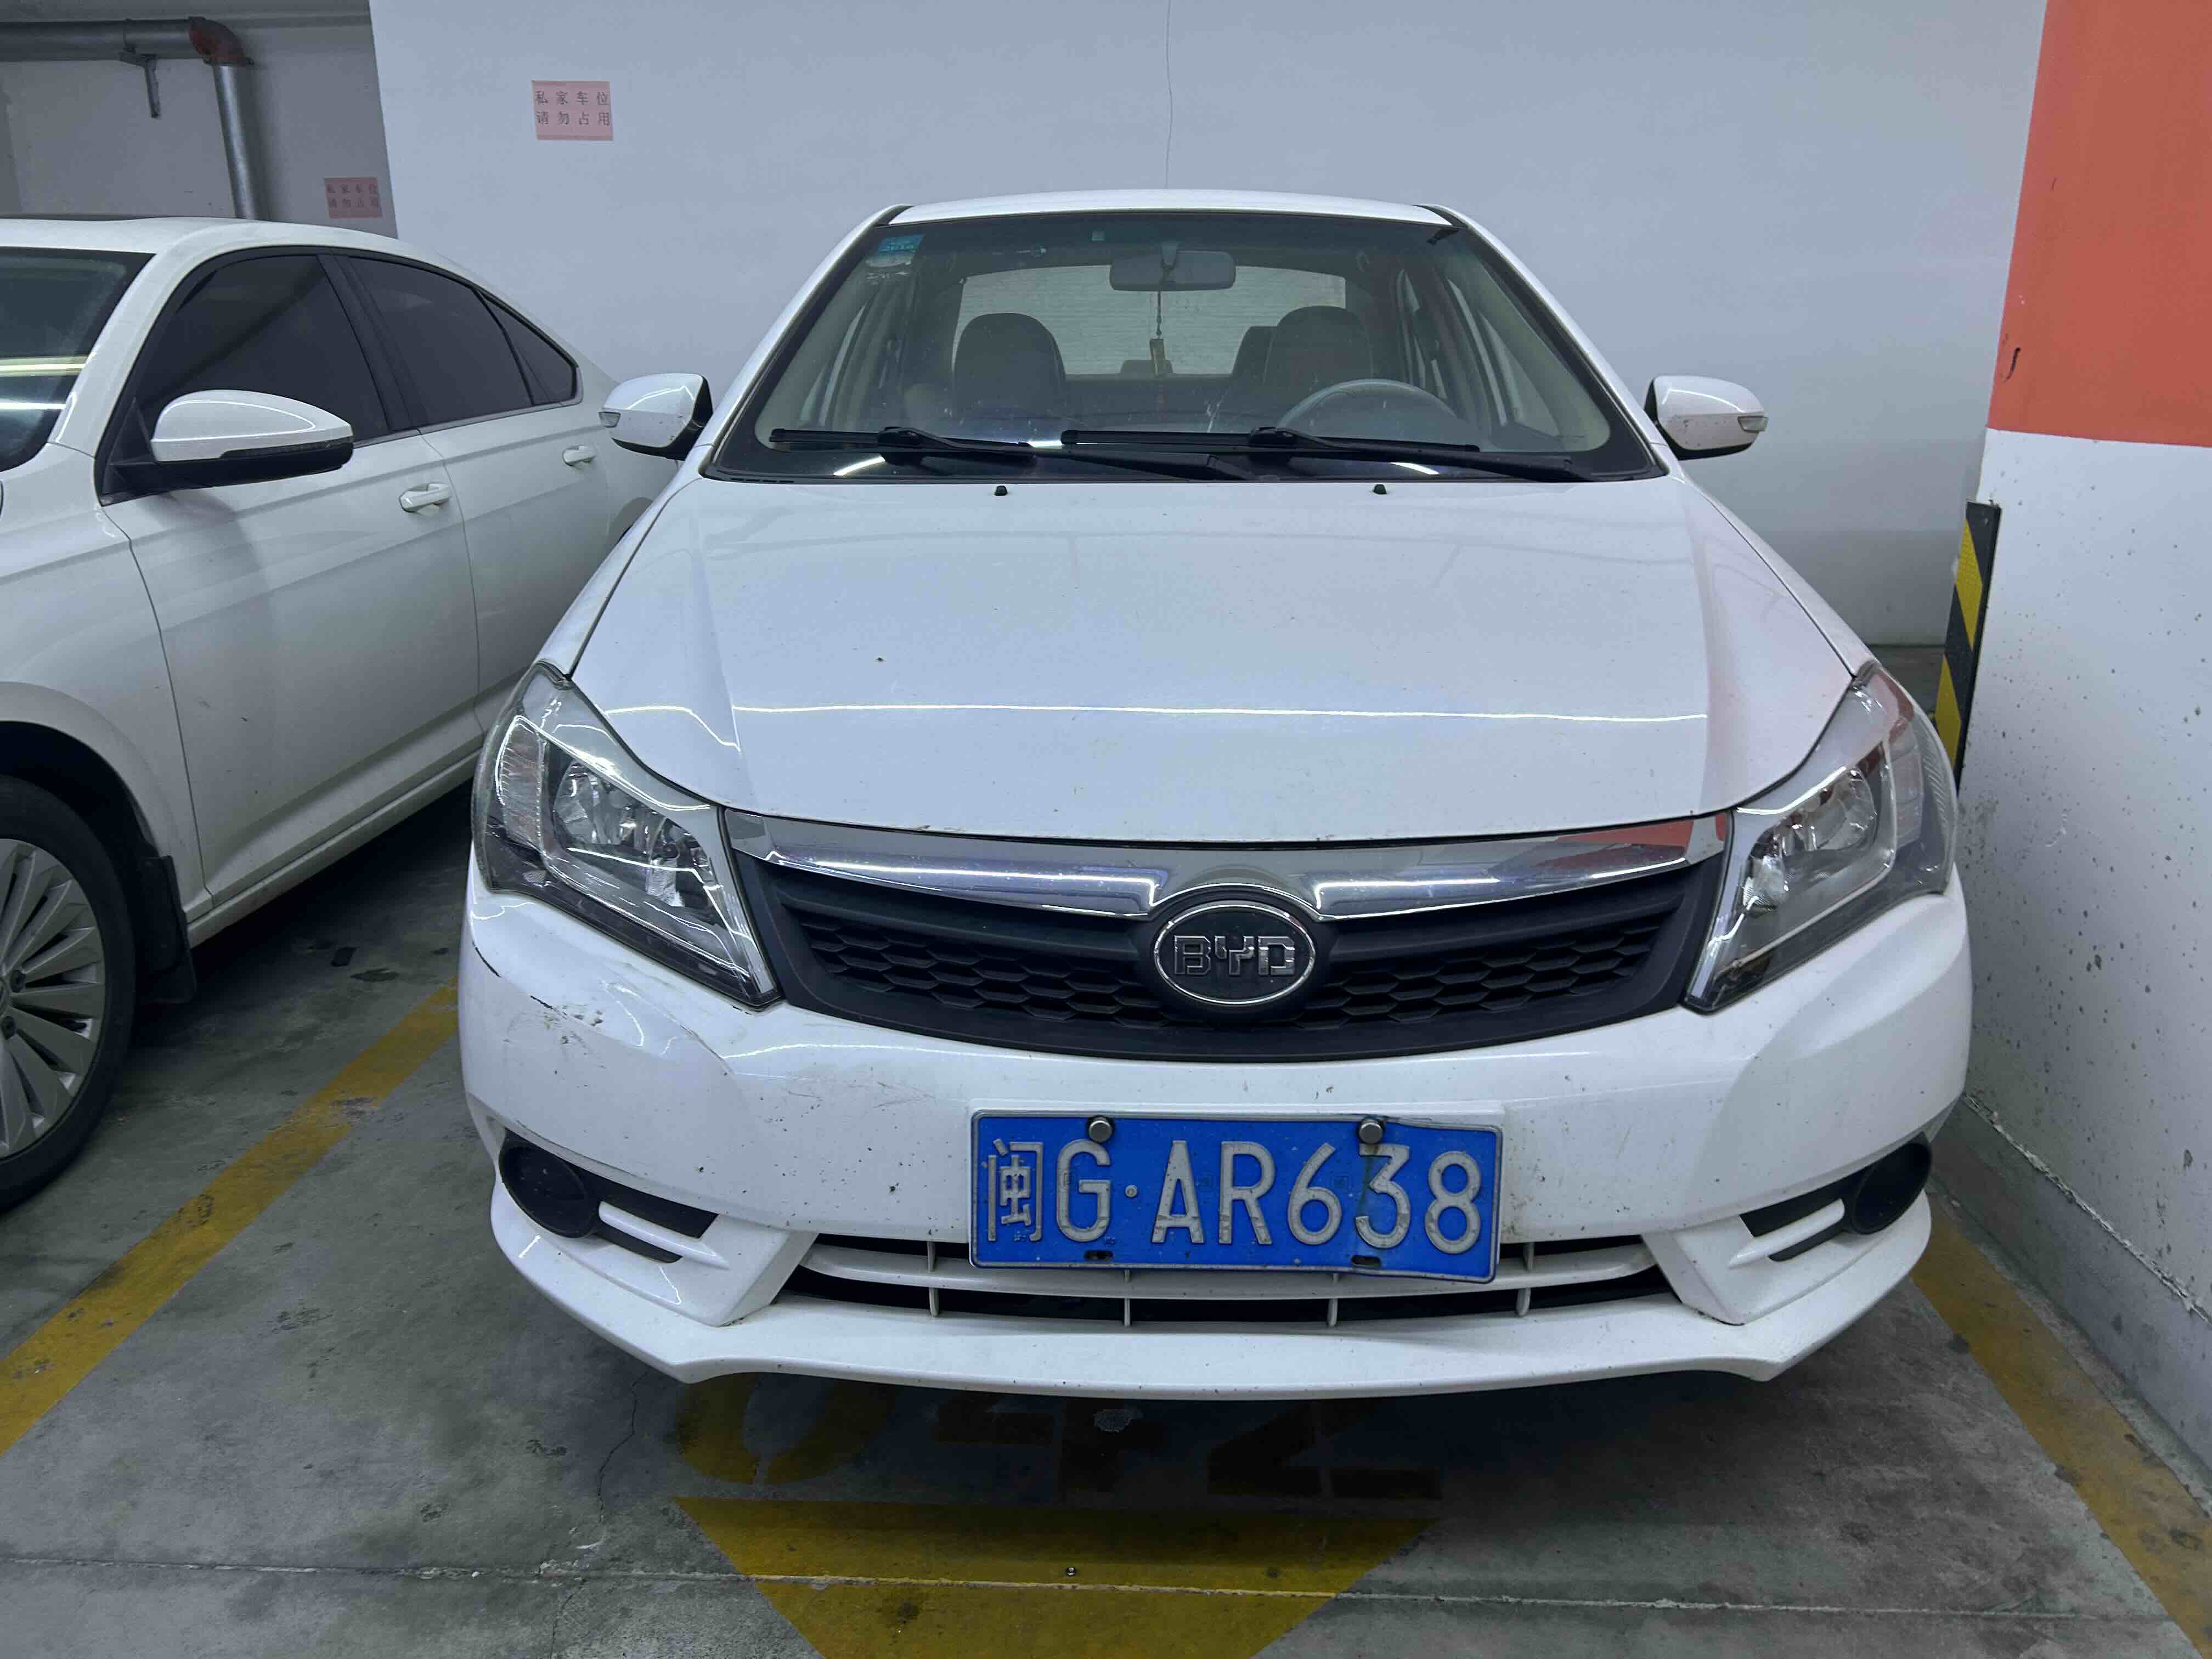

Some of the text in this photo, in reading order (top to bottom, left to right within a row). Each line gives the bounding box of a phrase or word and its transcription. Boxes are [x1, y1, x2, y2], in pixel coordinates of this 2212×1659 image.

[535, 91, 610, 105] 私家车位
[536, 111, 611, 126] 请勿占用
[1174, 935, 1295, 975] BYD
